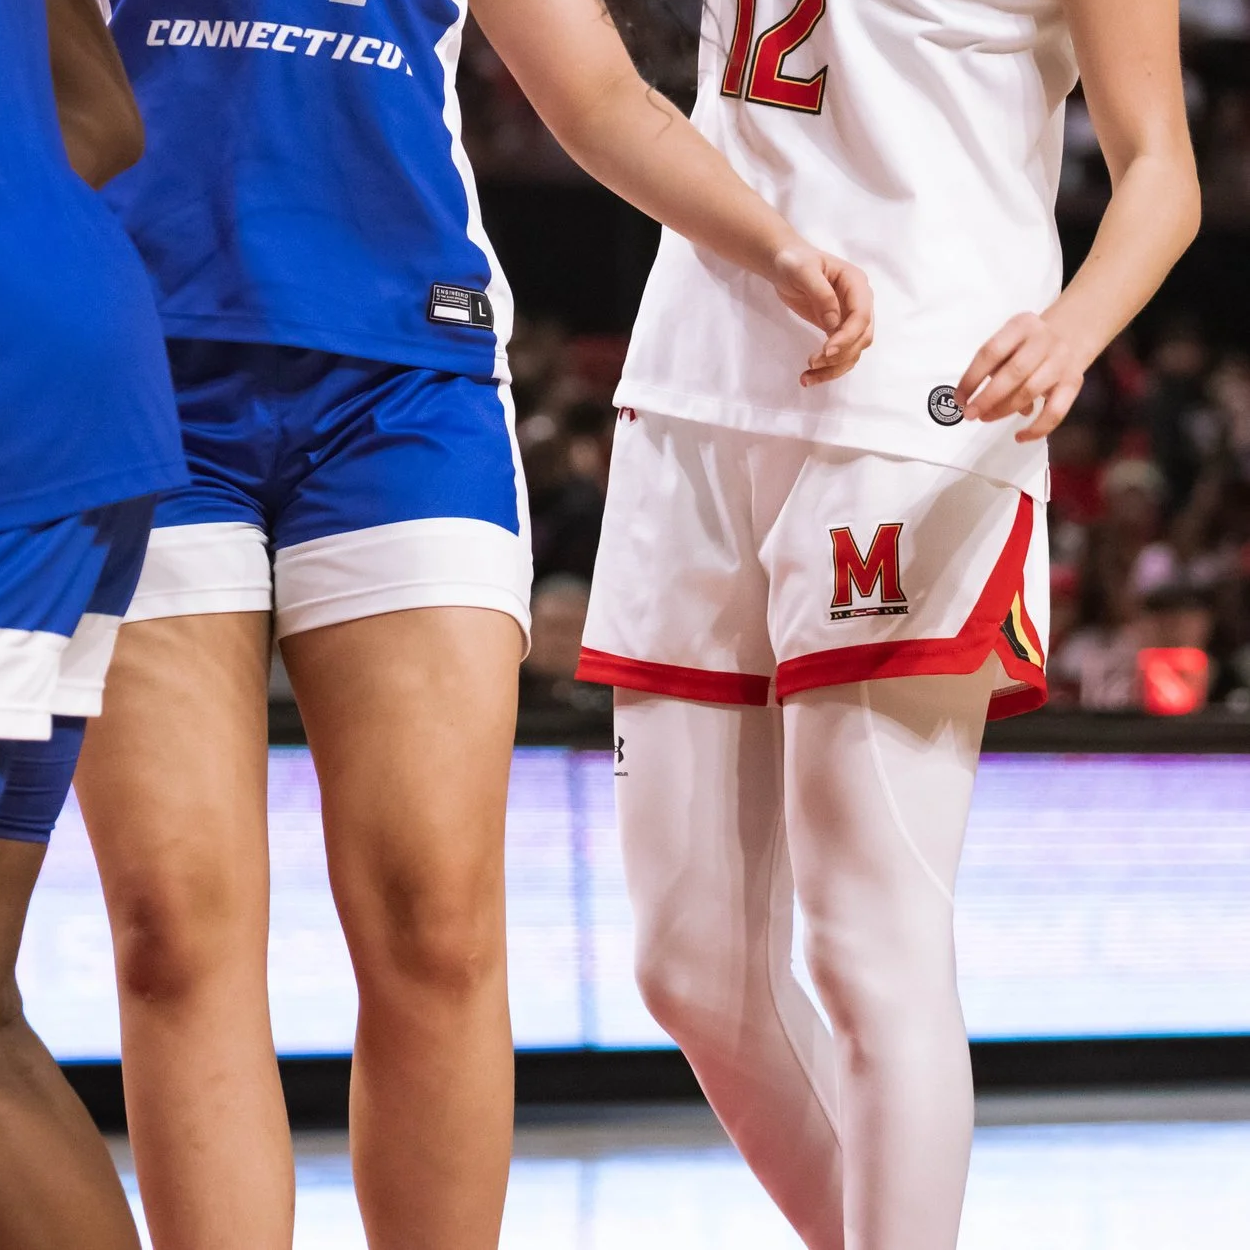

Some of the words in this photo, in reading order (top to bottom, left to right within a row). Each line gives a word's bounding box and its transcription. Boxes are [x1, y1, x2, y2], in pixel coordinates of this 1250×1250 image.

[146, 19, 413, 77] CONNECTICU
[478, 301, 487, 317] L
[829, 523, 907, 608] M
